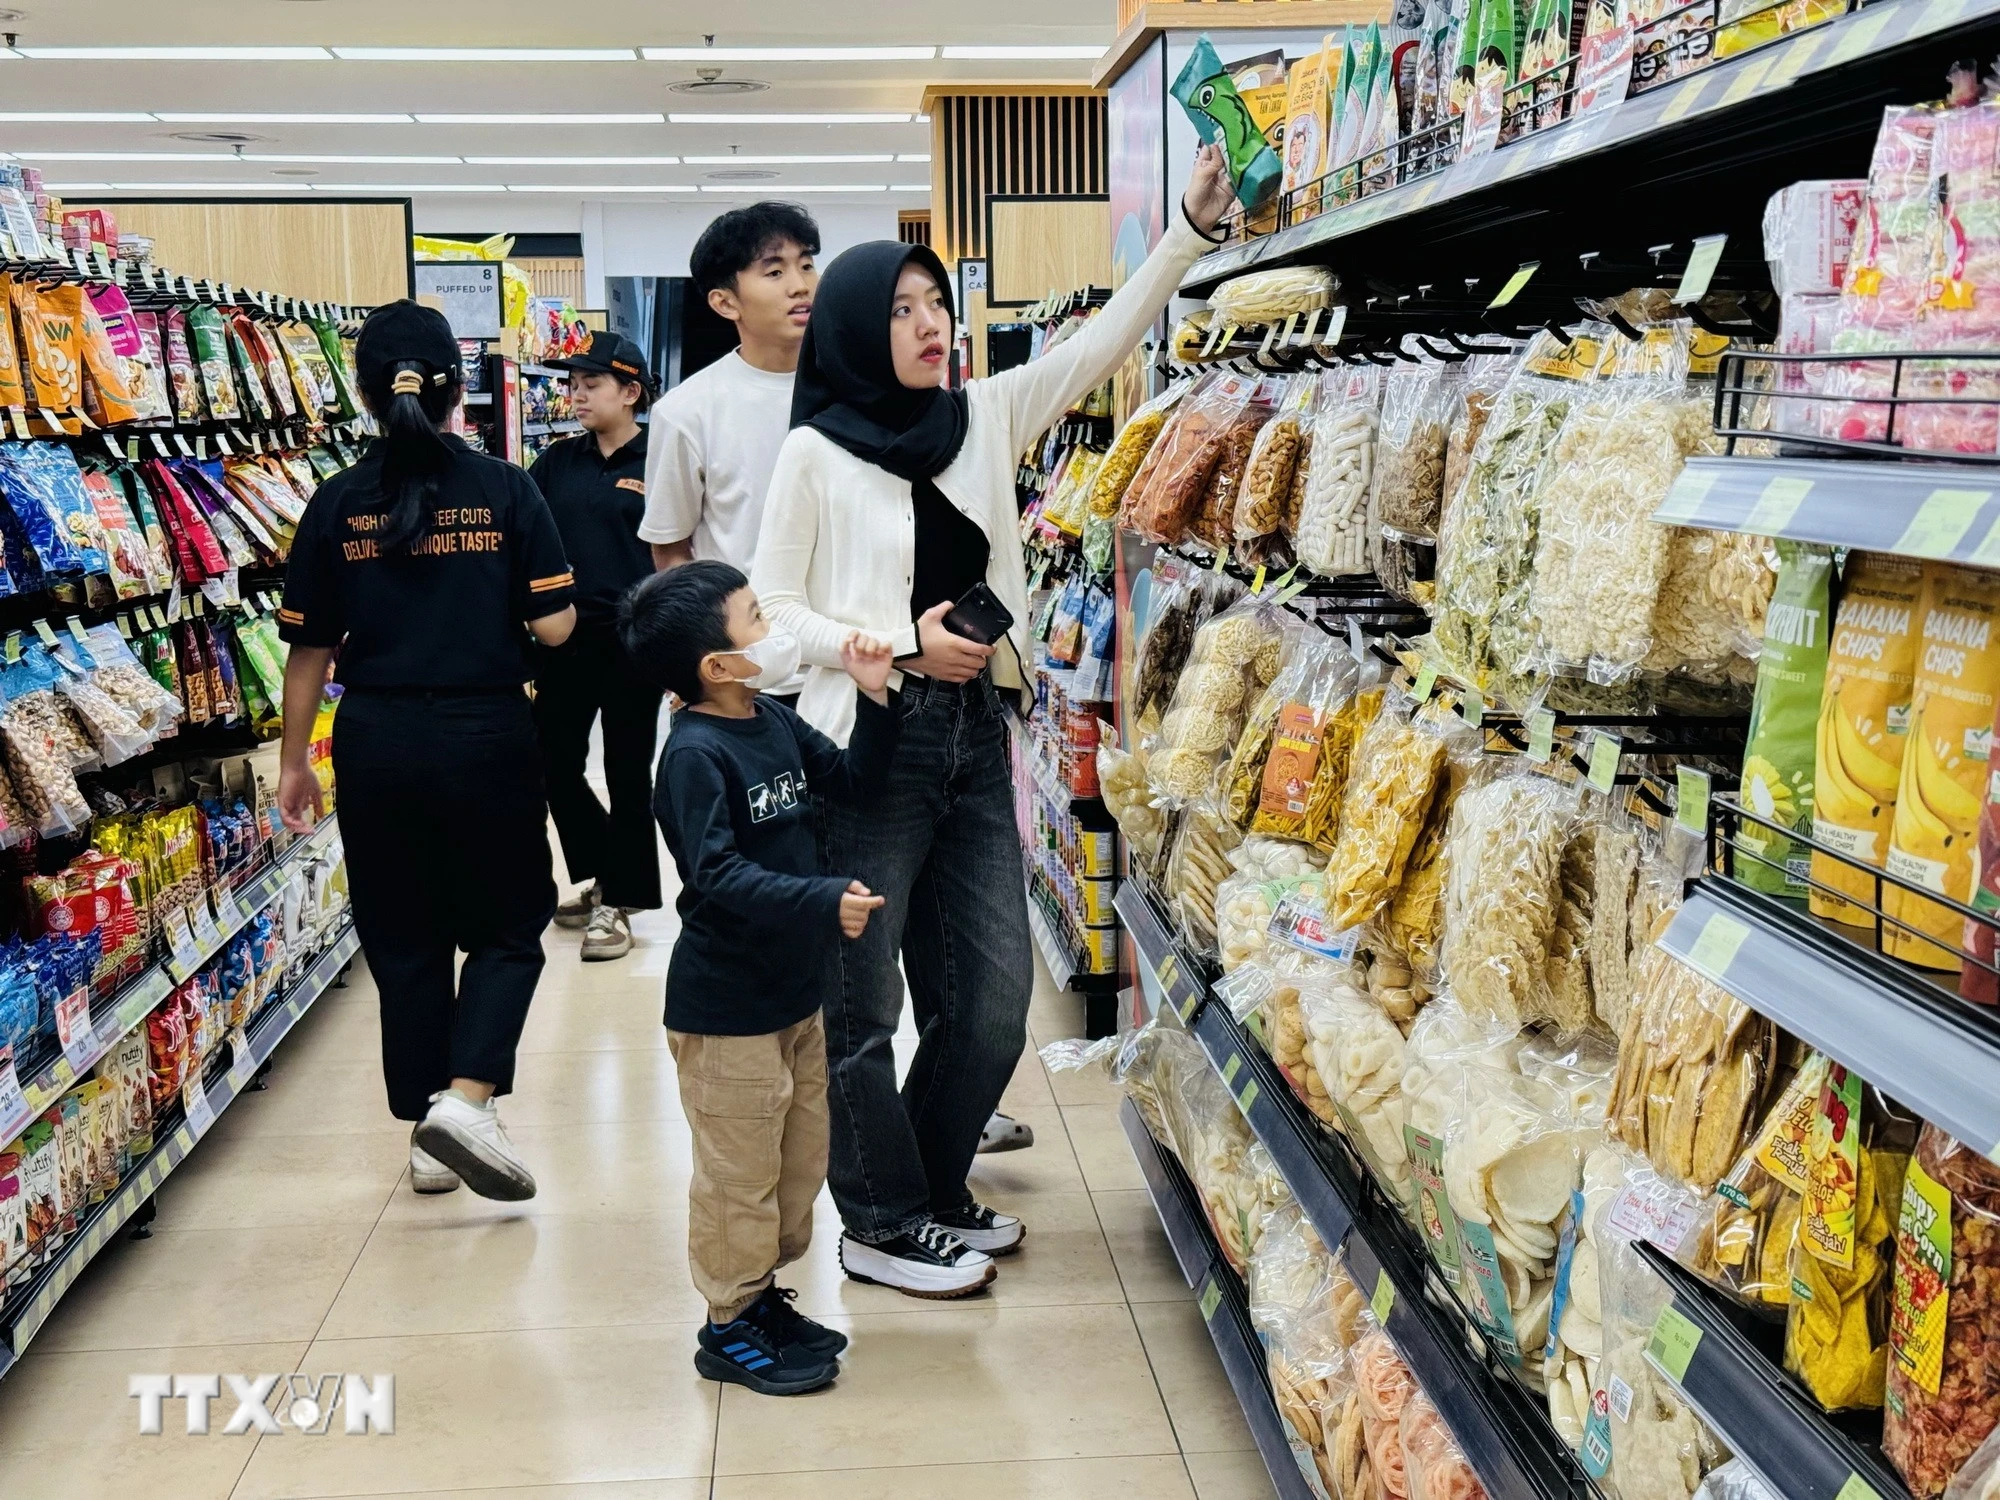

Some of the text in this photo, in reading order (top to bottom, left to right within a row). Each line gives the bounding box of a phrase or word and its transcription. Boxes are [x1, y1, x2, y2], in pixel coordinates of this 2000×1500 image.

[483, 268, 492, 280] 8
[968, 265, 977, 277] 9
[436, 285, 493, 293] PUFFED UP
[347, 515, 378, 532] "HIGH
[460, 508, 492, 525] CUTS
[342, 531, 503, 562] DELIVE UNIQUE TASTE"
[1835, 600, 1911, 636] BANANA
[1922, 609, 1990, 651] BANANA
[1835, 631, 1886, 662] CHIPS
[1924, 644, 1966, 678] CHIPS
[1835, 840, 1855, 852] CHIPS
[166, 921, 176, 948] 2
[121, 1047, 144, 1064] nutify
[1722, 1185, 1736, 1198] 170
[1912, 1220, 1945, 1273] Corn
